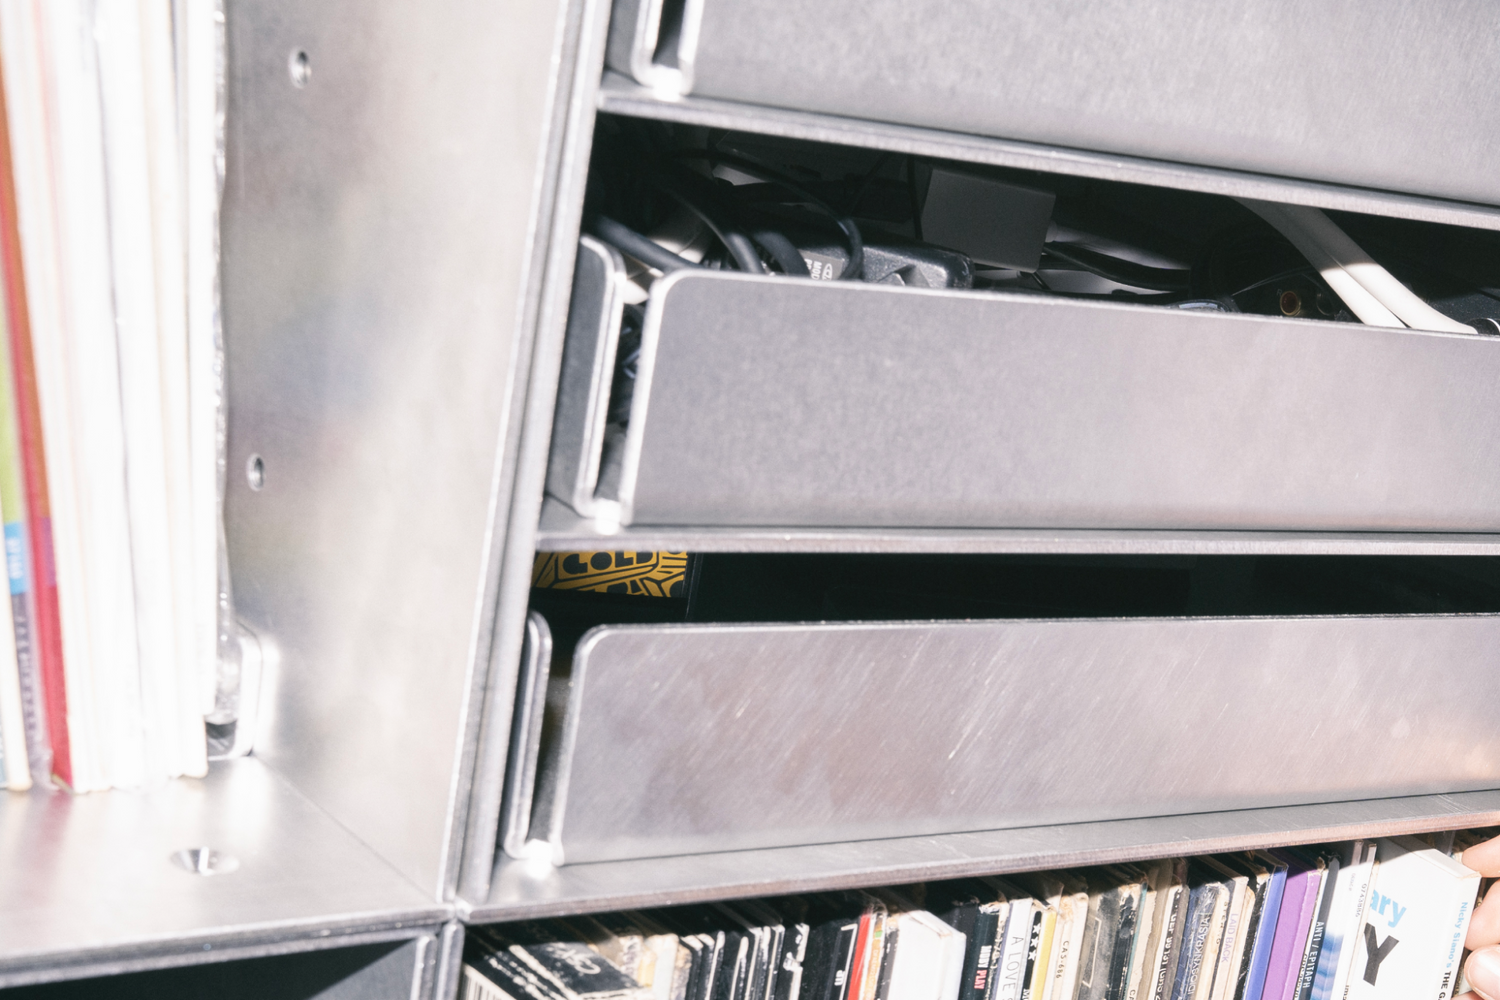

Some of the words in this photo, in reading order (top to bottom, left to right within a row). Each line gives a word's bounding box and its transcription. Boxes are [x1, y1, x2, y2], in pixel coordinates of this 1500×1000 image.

[1226, 913, 1238, 933] LAID
[1370, 889, 1407, 928] ary
[1454, 902, 1468, 927] Nicky
[1010, 937, 1024, 945] A
[1312, 921, 1324, 940] ANTI
[1054, 941, 1070, 978] CAS-686
[1186, 916, 1211, 994] IDIOSYNKRASIA
[1220, 937, 1233, 962] BACK
[1363, 922, 1400, 987] Y
[1445, 932, 1461, 968] Siano's
[973, 969, 987, 989] PLAY
[1001, 953, 1021, 991] LOVE
[1301, 951, 1318, 988] EPITAPH
[1440, 970, 1452, 989] THE
